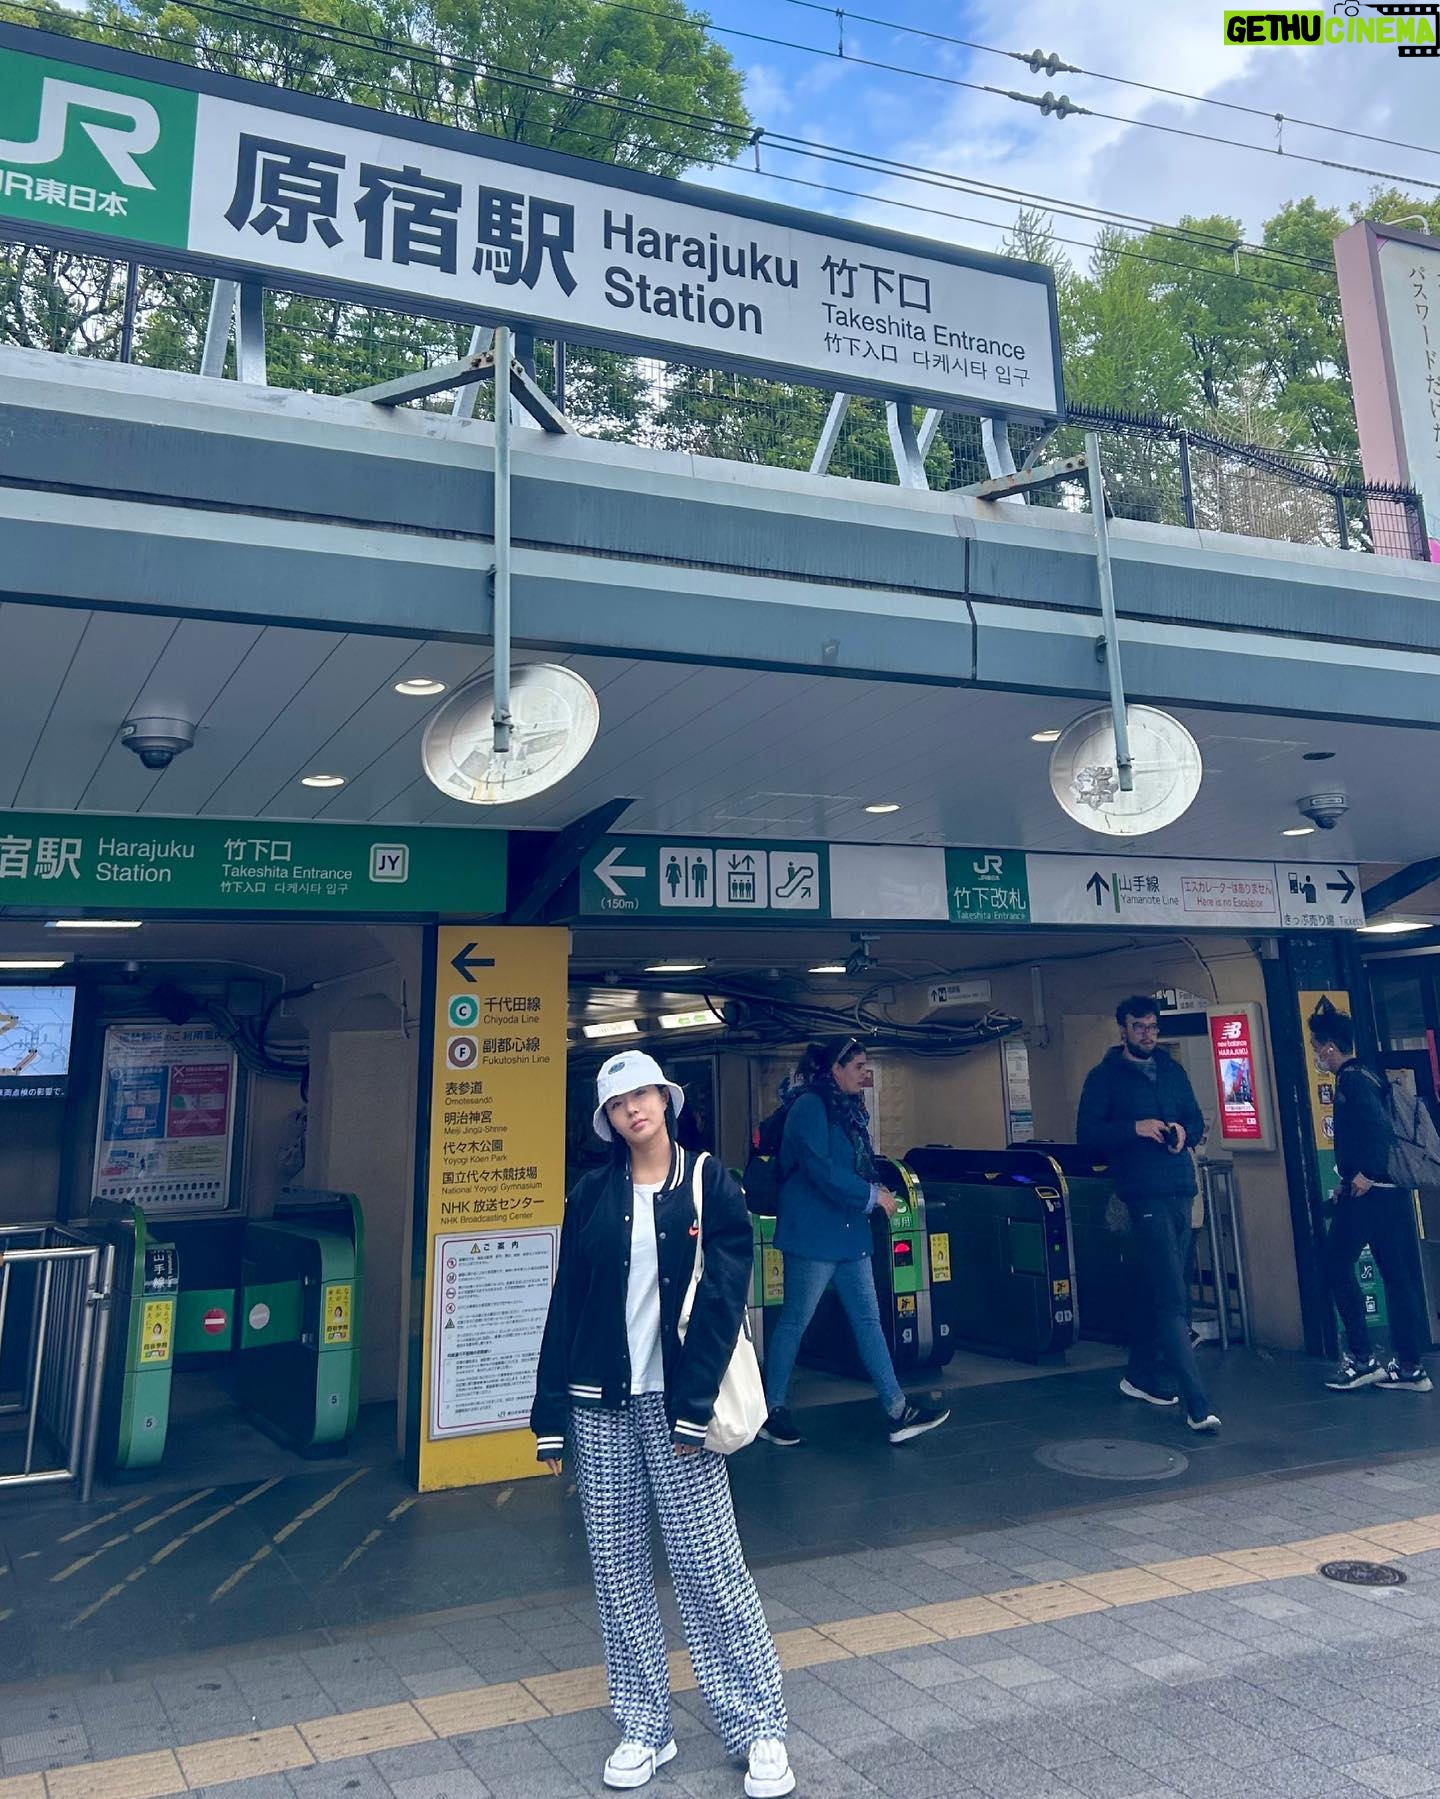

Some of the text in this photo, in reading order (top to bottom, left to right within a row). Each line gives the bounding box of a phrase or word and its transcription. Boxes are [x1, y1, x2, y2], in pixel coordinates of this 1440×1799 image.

[224, 132, 578, 298] 原宿駅
[603, 209, 799, 288] Harajuku
[821, 254, 932, 314] 竹下口
[604, 266, 763, 335] Station
[822, 302, 1026, 361] Takeshita Entrance
[824, 332, 898, 363] 竹下入口
[912, 354, 1031, 388] 다케시타 입구
[98, 837, 195, 862] Harajuku
[223, 838, 292, 861] 竹下口
[378, 855, 400, 871] JY
[973, 855, 1003, 874] JR
[96, 862, 172, 883] Station
[222, 864, 353, 880] Takeshita Entrance
[220, 881, 266, 893] 竹下入口
[326, 884, 349, 895] 입구
[1118, 874, 1161, 893] 山手線
[600, 899, 640, 911] (150m)
[953, 886, 1026, 910] 竹下改札
[1120, 894, 1180, 906] Yamanote Line
[957, 911, 1026, 920] Takeshita Entrance
[459, 1006, 467, 1017] C
[483, 996, 541, 1013] 千代田線
[484, 1014, 540, 1025] Chiyoda Line
[482, 1037, 540, 1053] 副都心線
[483, 1055, 550, 1065] Fukutoshin Line
[445, 1081, 483, 1095] 表参道
[444, 1111, 492, 1125] 明治神宮
[443, 1139, 503, 1155] 代々木公園
[443, 1156, 468, 1165] Yoyogi
[491, 1153, 507, 1161] Park
[443, 1166, 537, 1184] 国立代々木競技場
[442, 1182, 542, 1194] National Yoyogi Gymnasium
[441, 1197, 544, 1214] NHK 放送センター
[460, 1213, 507, 1224] Broadcasting
[509, 1212, 533, 1220] Center
